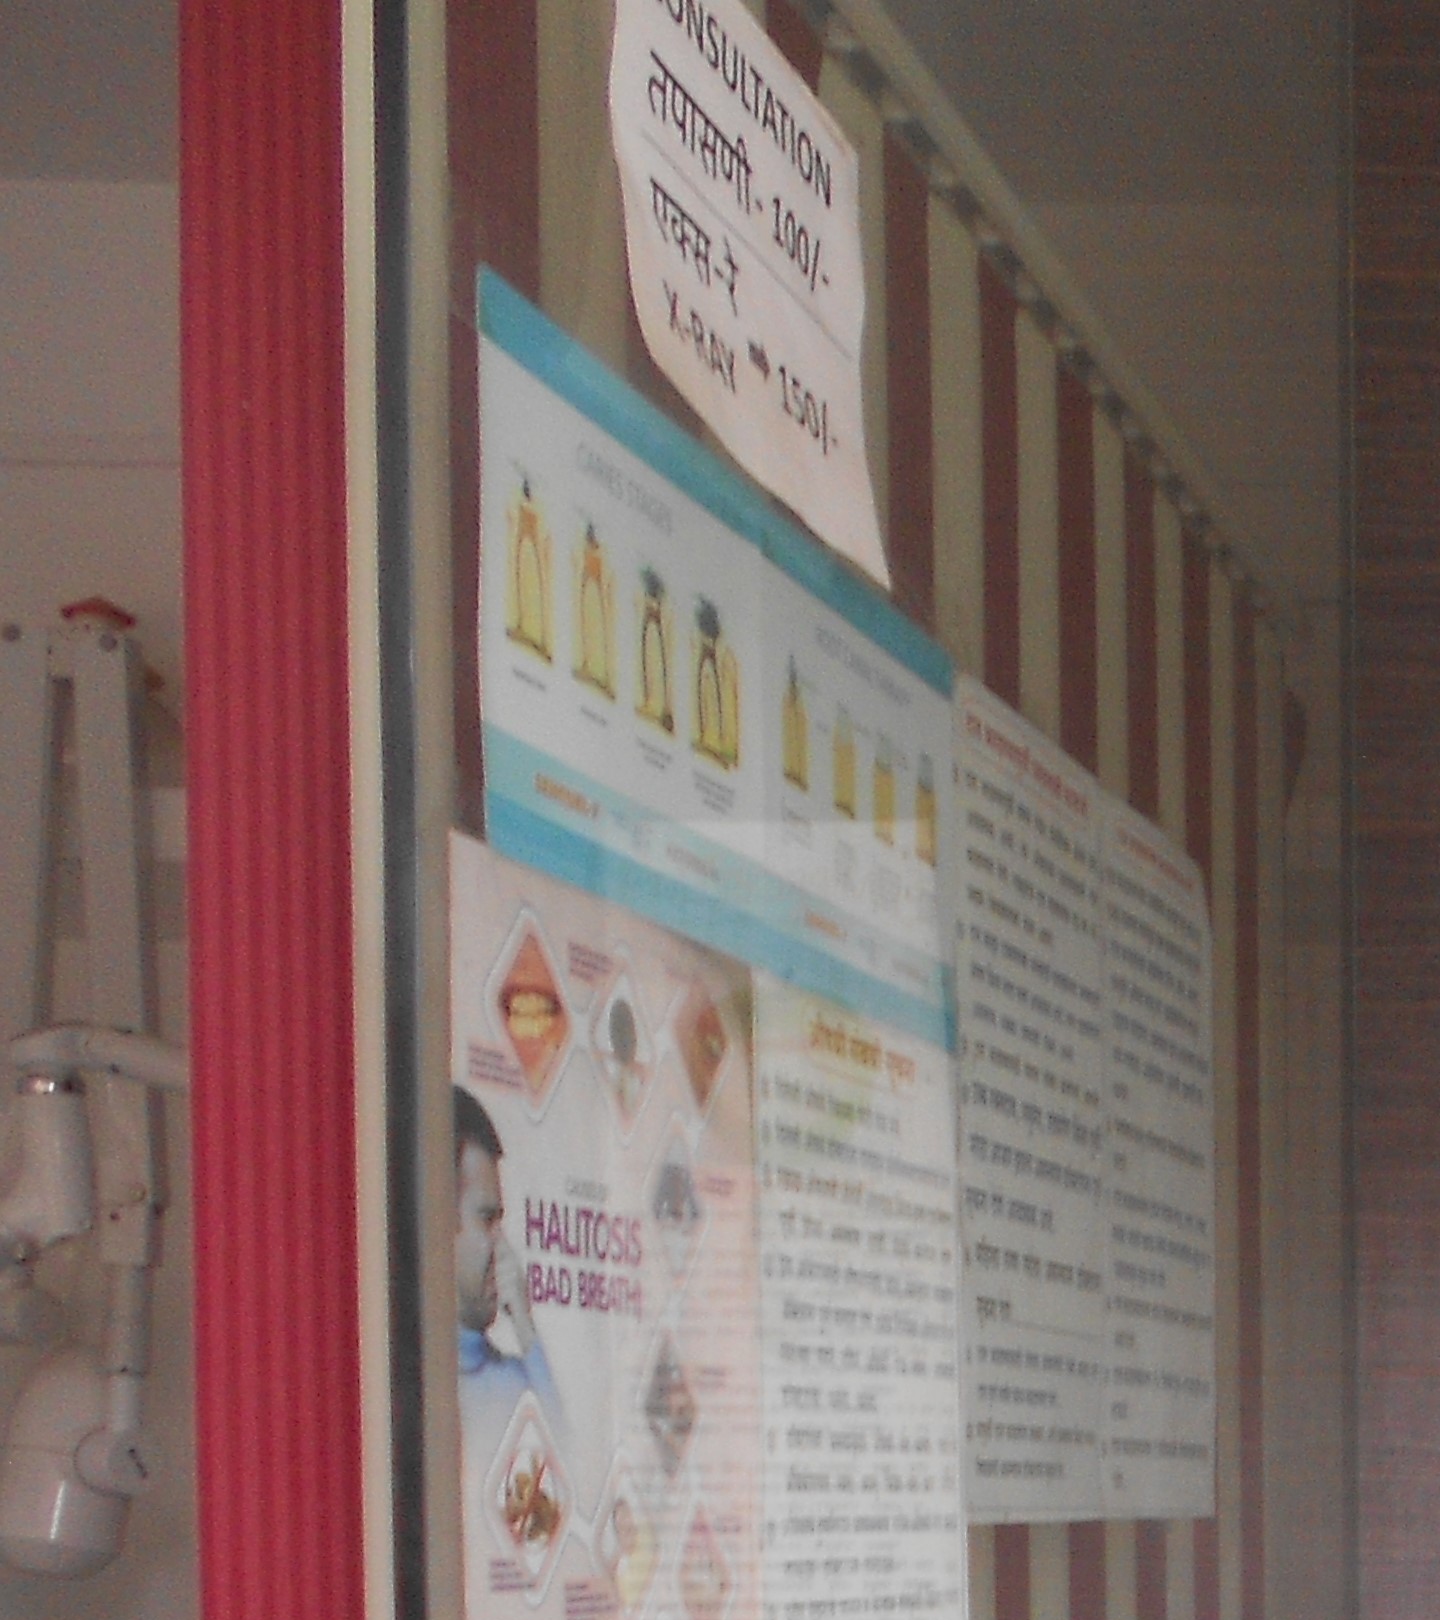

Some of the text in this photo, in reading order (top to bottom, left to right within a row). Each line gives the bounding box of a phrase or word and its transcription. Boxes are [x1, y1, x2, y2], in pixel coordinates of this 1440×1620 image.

[658, 0, 831, 208] NSULTATION
[772, 197, 830, 292] 100/-
[663, 279, 839, 460] X-RAY 150/-
[525, 1197, 643, 1267] HALITOSIS
